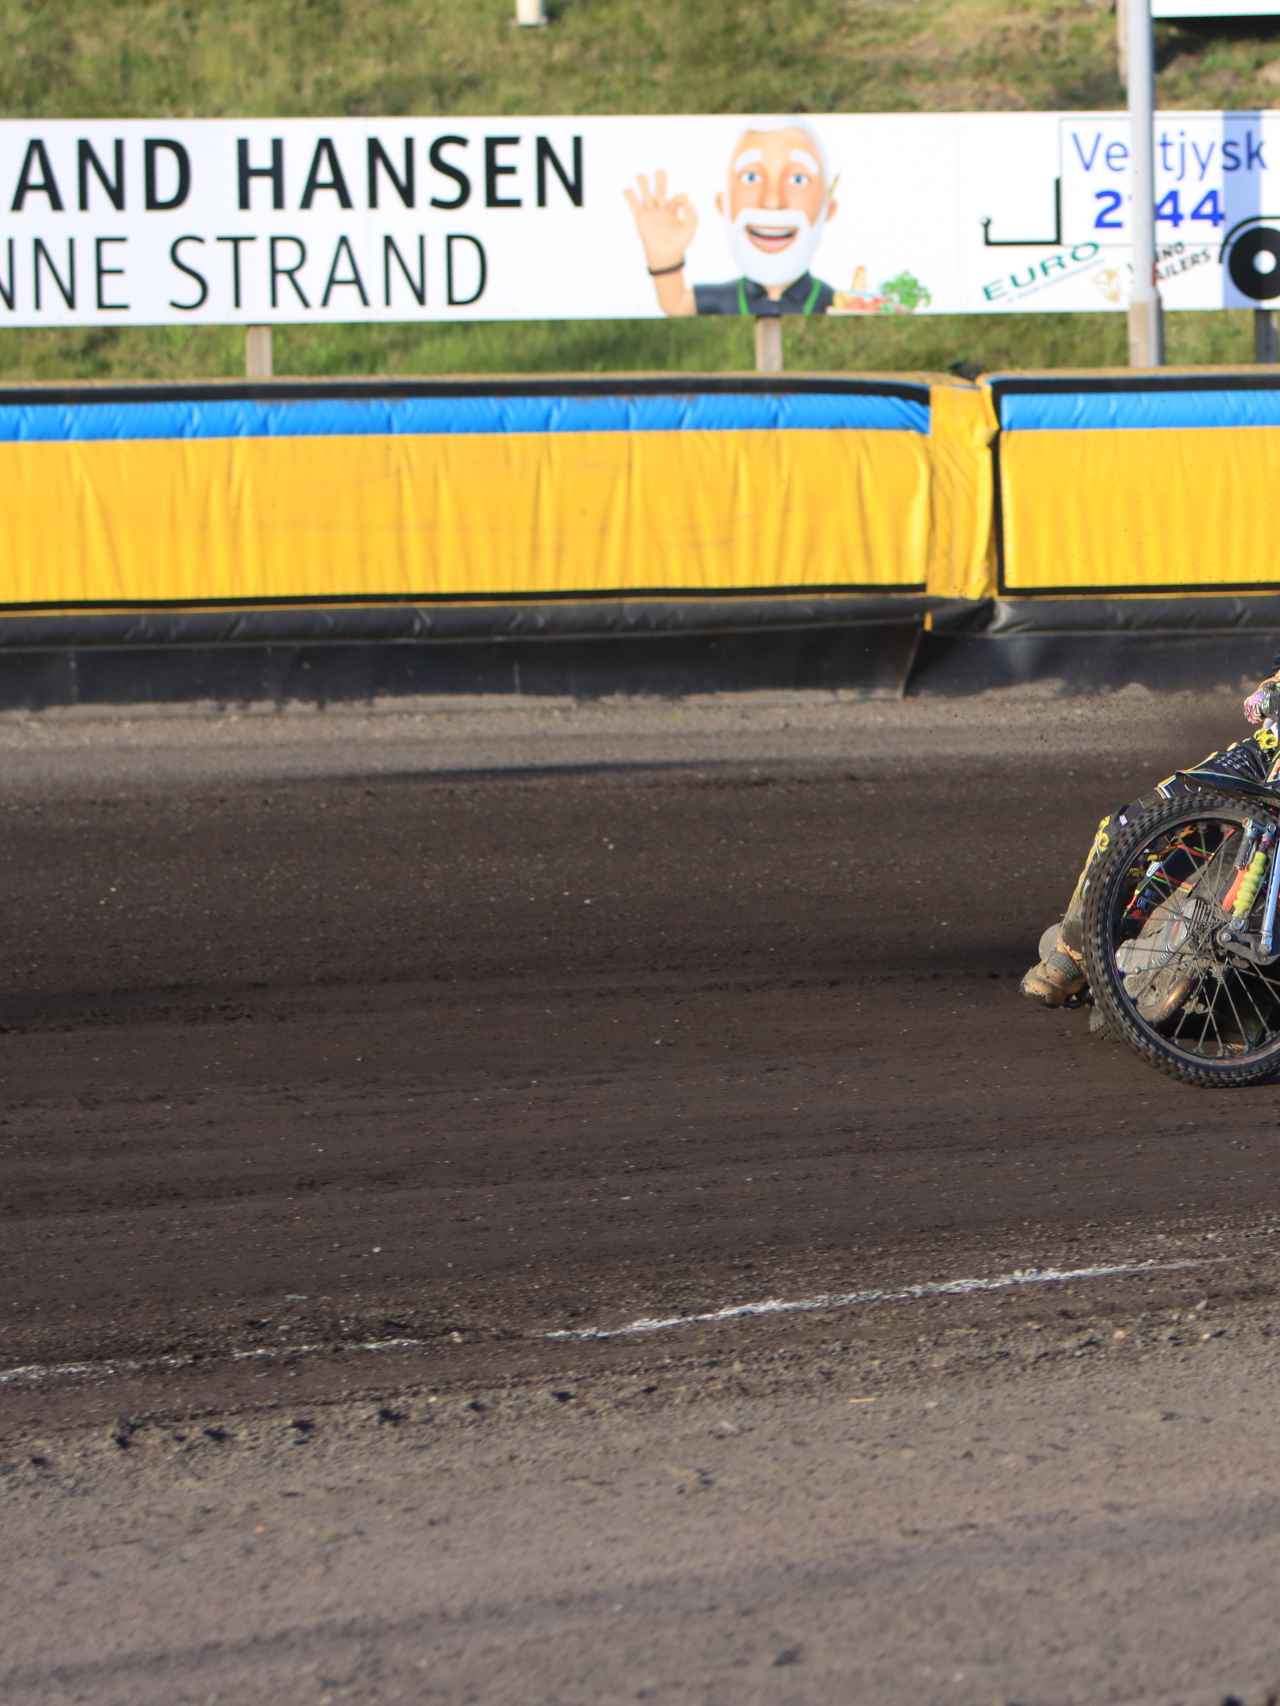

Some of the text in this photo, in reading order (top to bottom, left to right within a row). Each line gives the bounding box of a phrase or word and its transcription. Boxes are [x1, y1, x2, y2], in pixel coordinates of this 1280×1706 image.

[10, 134, 585, 212] AND HANSEN
[1071, 129, 1268, 181] Vetjysk
[1093, 189, 1226, 229] 244
[168, 234, 488, 311] STRAND
[983, 240, 1101, 301] EURO
